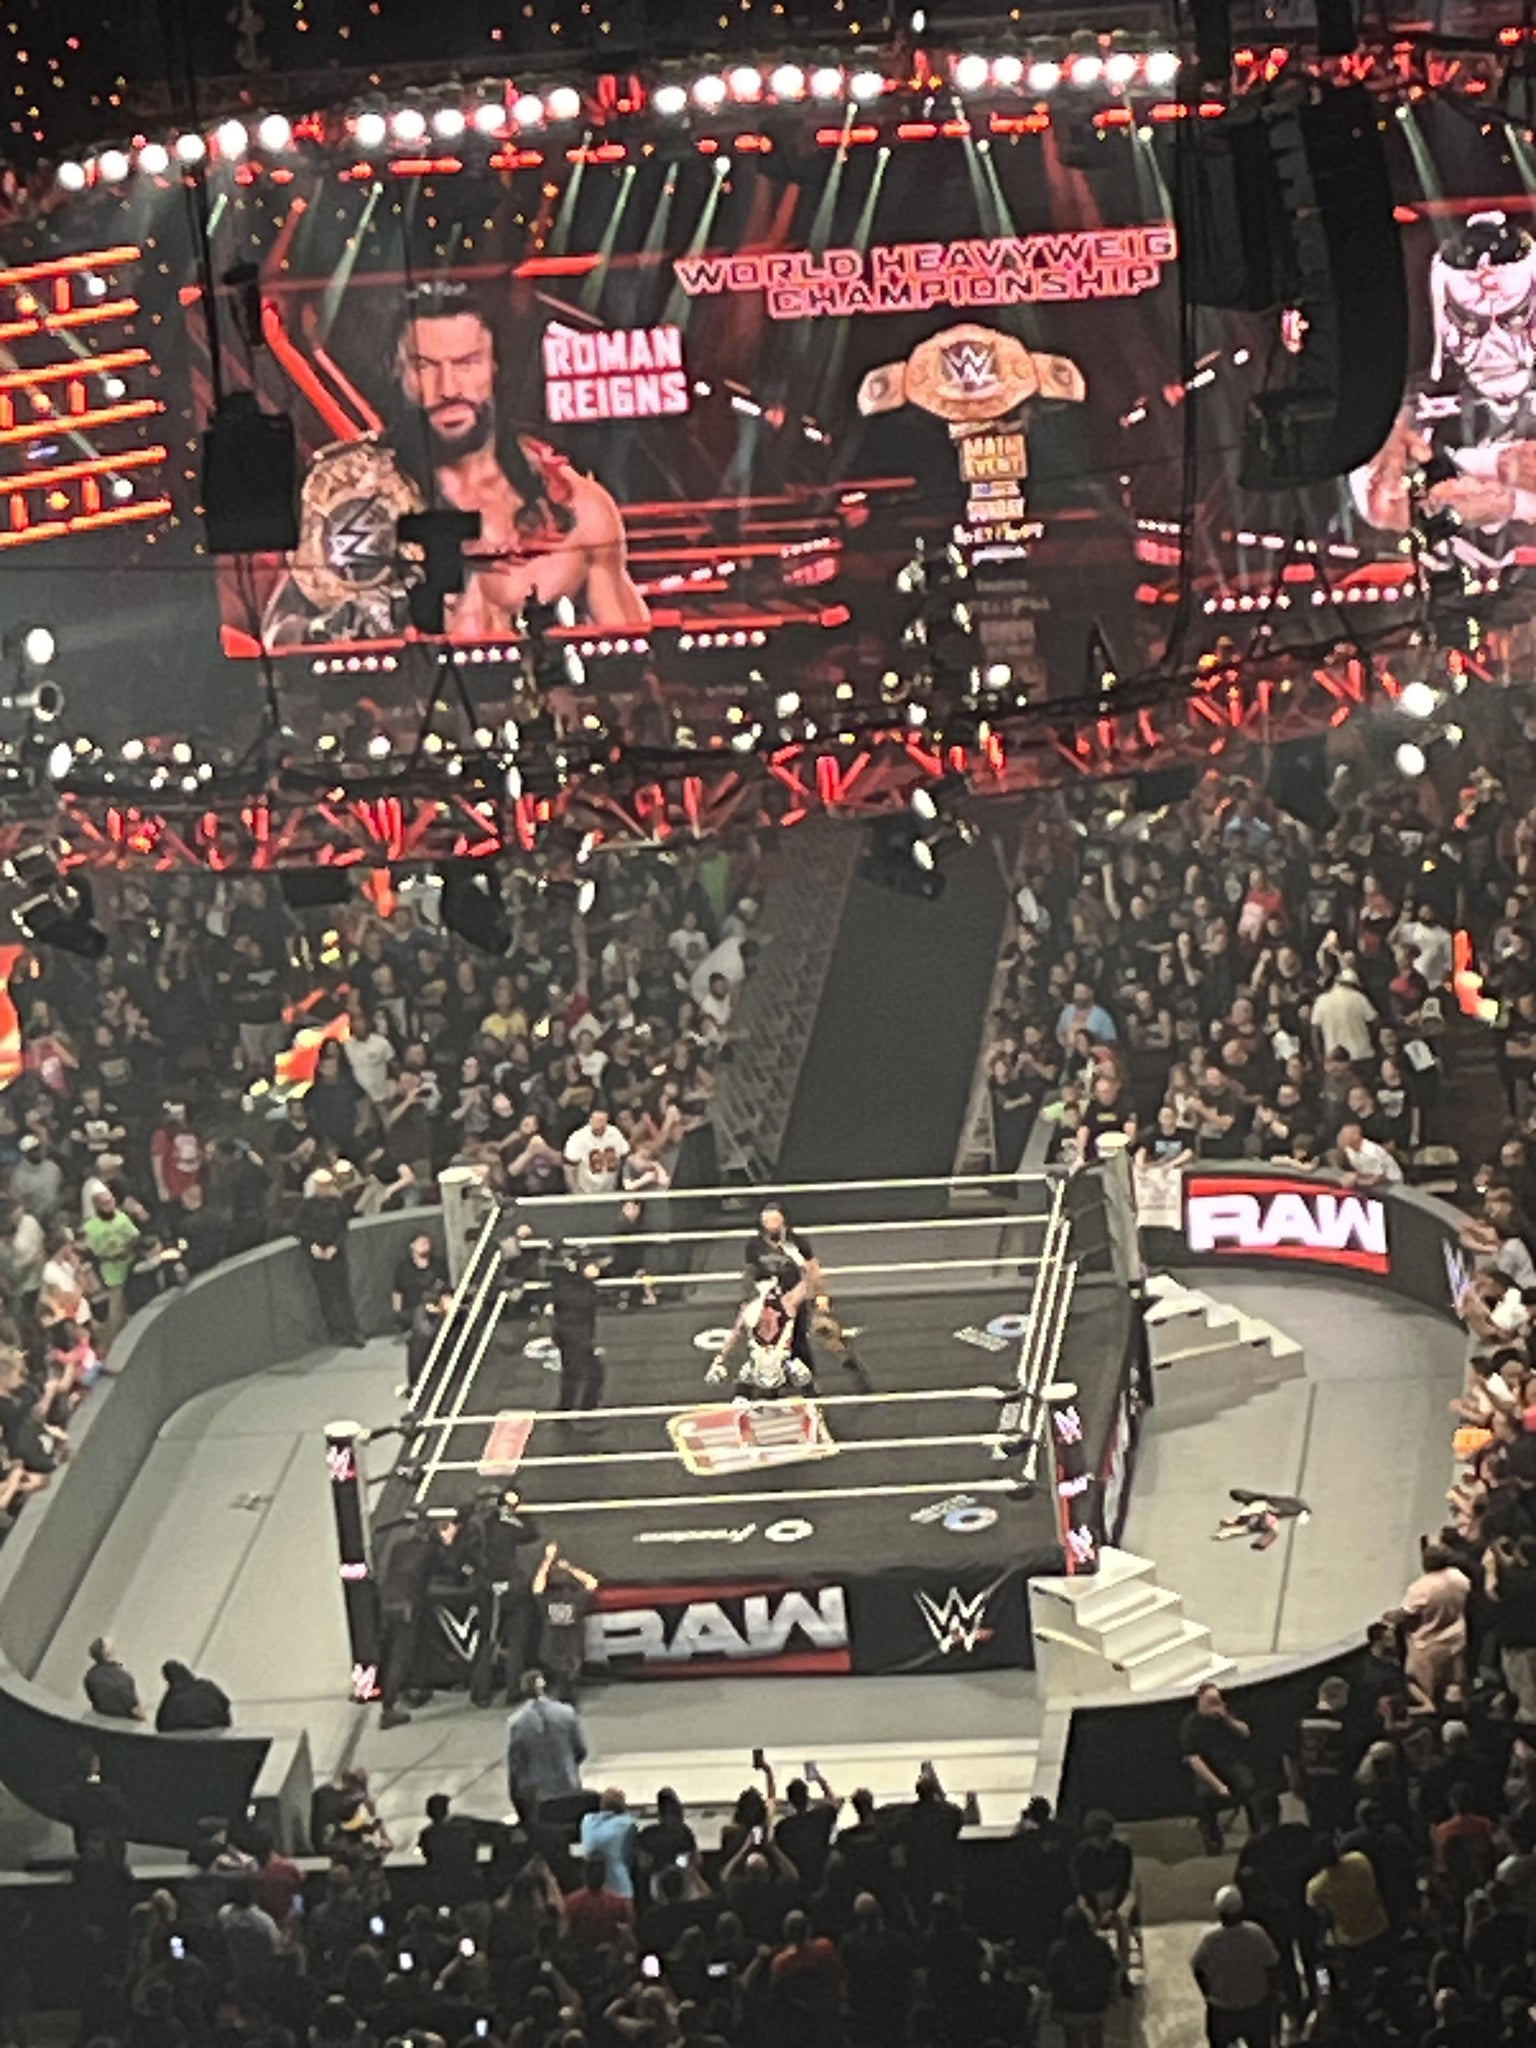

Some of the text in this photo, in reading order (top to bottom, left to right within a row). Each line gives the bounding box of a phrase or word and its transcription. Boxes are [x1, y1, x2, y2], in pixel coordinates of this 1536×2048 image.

[674, 226, 1176, 294] WORLD HEAVYWEIG
[768, 263, 1160, 319] CHAMPIONSHIP
[543, 325, 682, 376] ROMAN
[547, 374, 689, 422] REIGNS
[1187, 1193, 1387, 1254] RAW
[583, 1586, 848, 1664] RAW
